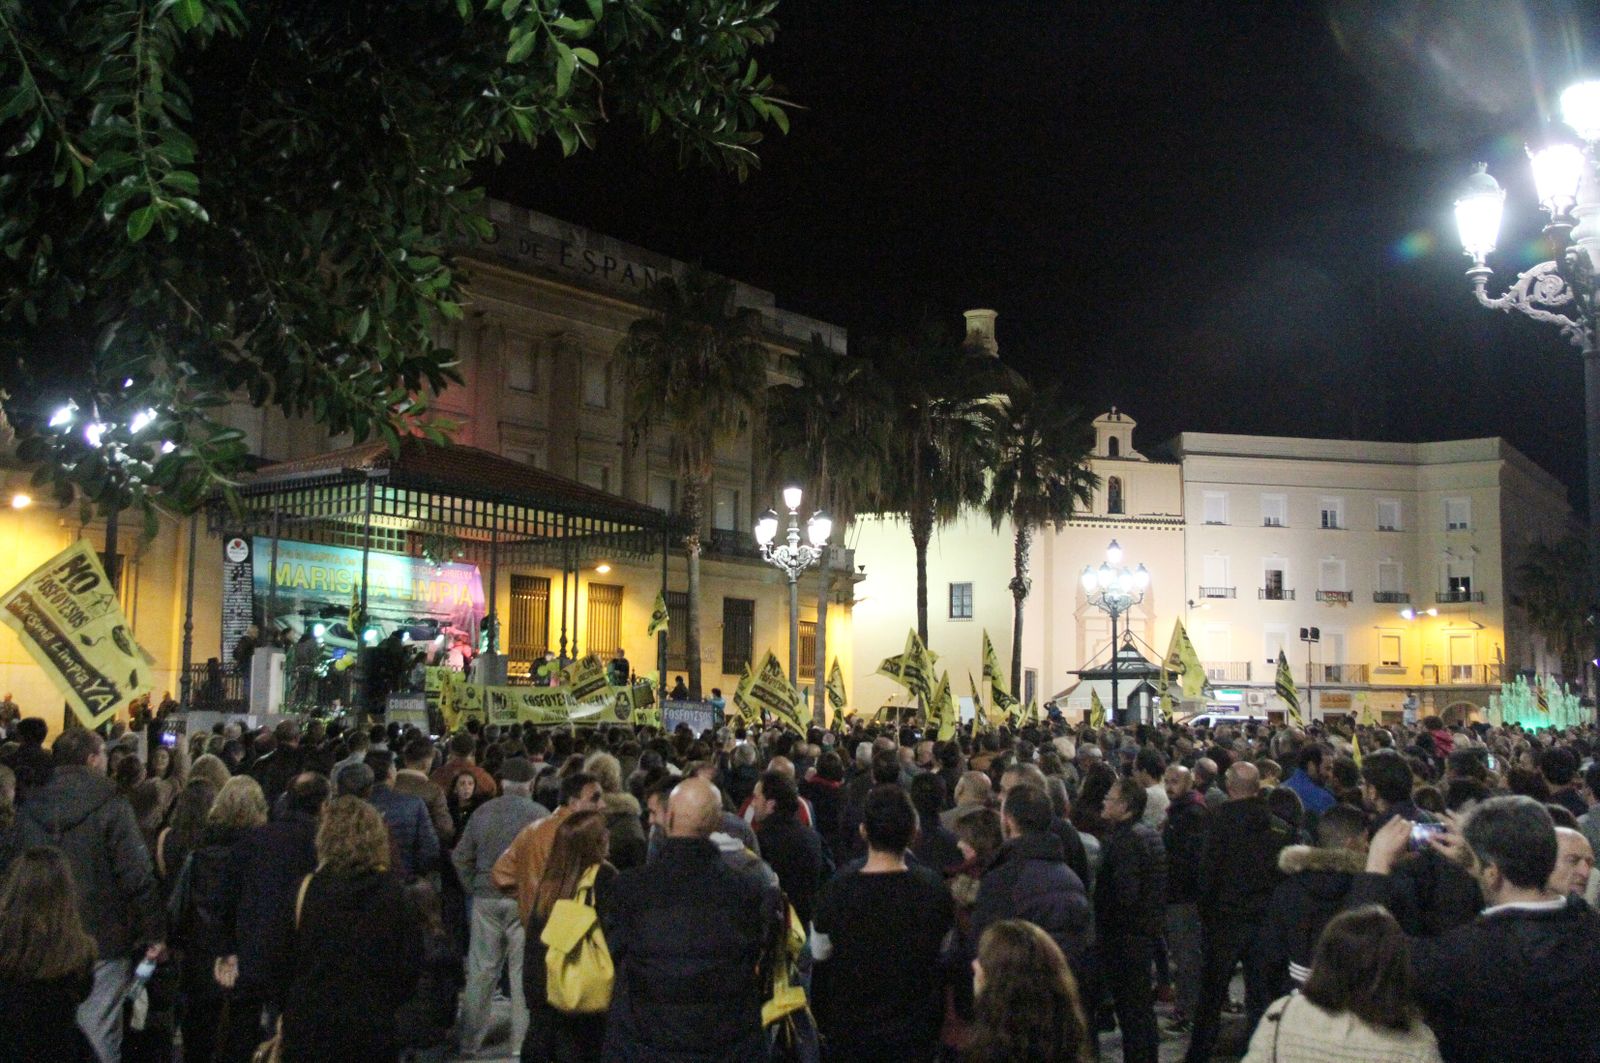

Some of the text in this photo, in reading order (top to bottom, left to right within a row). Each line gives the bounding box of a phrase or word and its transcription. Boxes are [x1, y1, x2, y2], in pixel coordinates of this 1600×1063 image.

[53, 553, 100, 595] NO
[34, 573, 90, 629] FOSFOYESOS
[397, 575, 474, 608] LIMPIA
[83, 678, 114, 711] YA
[663, 706, 712, 722] FOSFOYESOS
